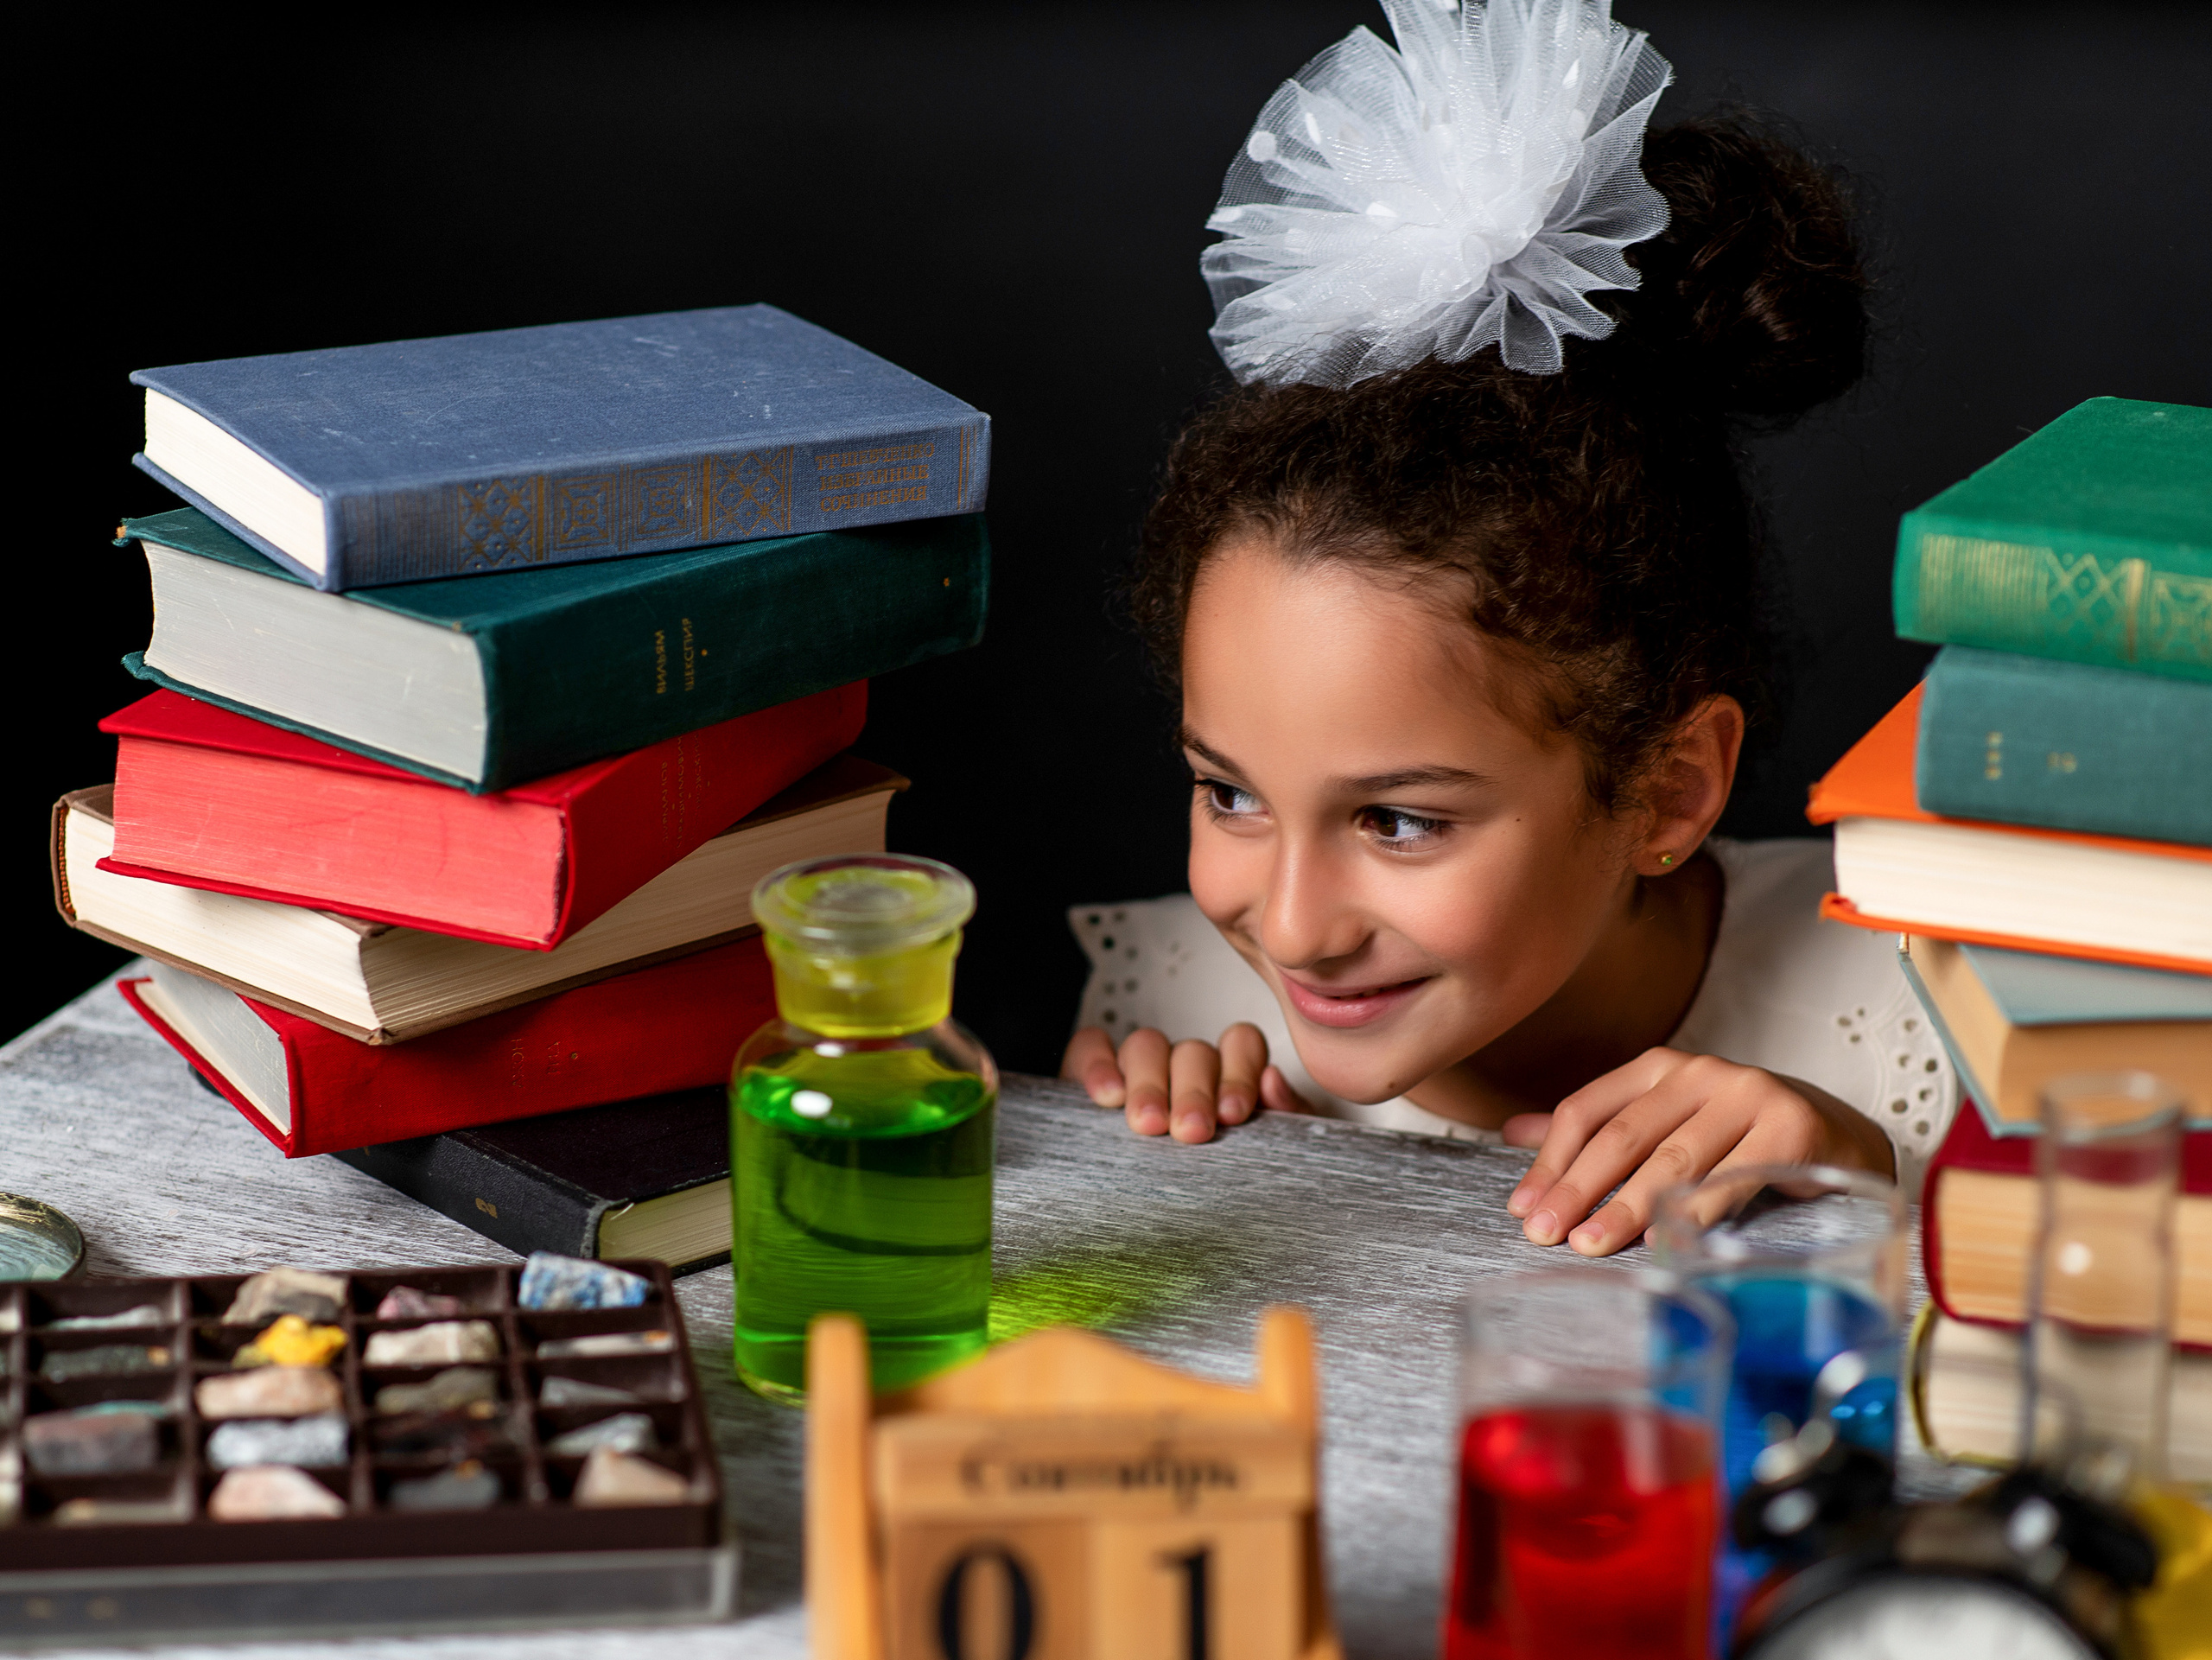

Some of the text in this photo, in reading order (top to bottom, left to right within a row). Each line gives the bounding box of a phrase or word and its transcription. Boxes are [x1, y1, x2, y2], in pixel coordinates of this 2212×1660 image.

[819, 464, 929, 492] ИЗБРАННЫЕ
[820, 486, 928, 512] СОЧИНЕНИЯ
[654, 629, 667, 695] ВИЛЬЯМ
[681, 617, 696, 692] ШЕКСПИР
